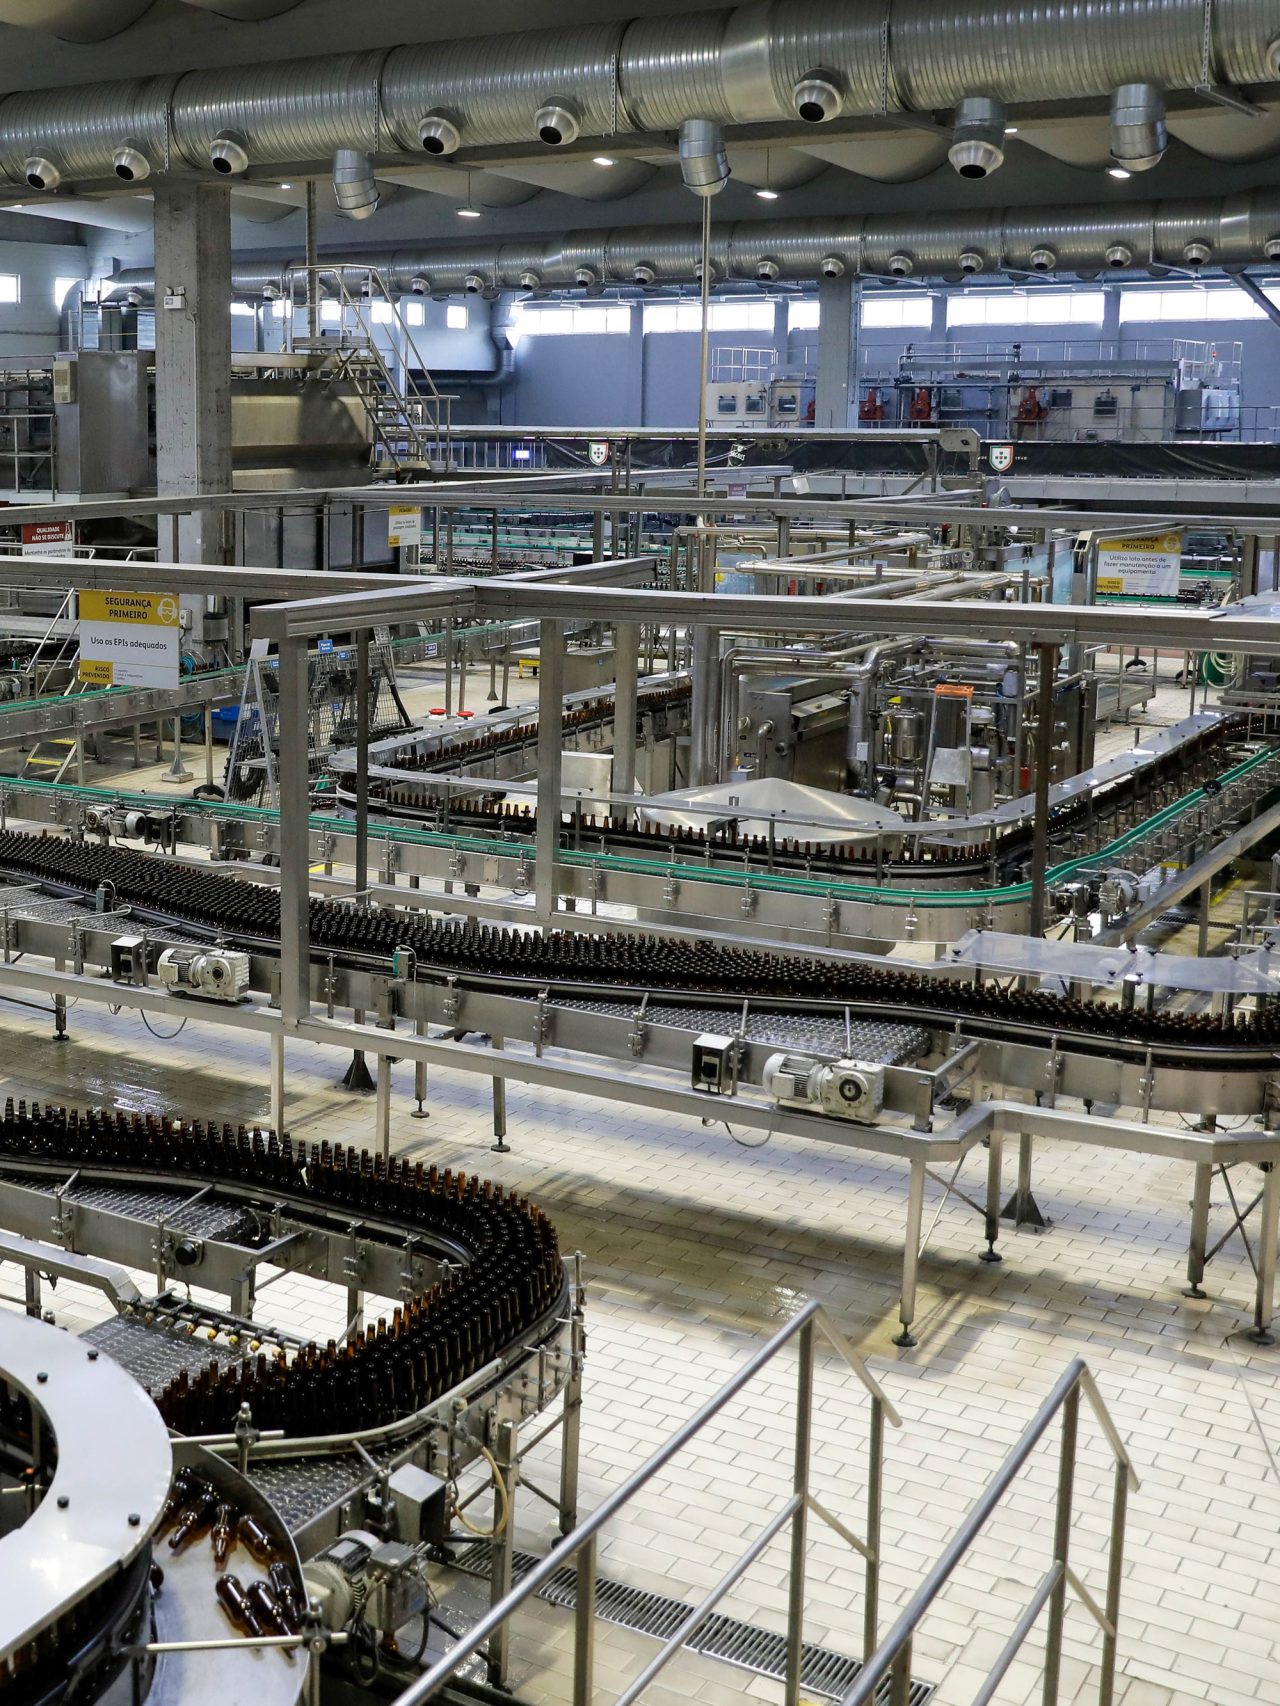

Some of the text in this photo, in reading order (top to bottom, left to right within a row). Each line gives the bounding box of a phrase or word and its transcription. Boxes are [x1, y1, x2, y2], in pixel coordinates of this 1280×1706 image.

[105, 597, 152, 609] SEGURANÇA
[109, 609, 148, 619] PRIMEIRO
[114, 638, 129, 647] EPIs
[130, 640, 167, 650] adequados
[82, 671, 109, 679] PREVENIDO
